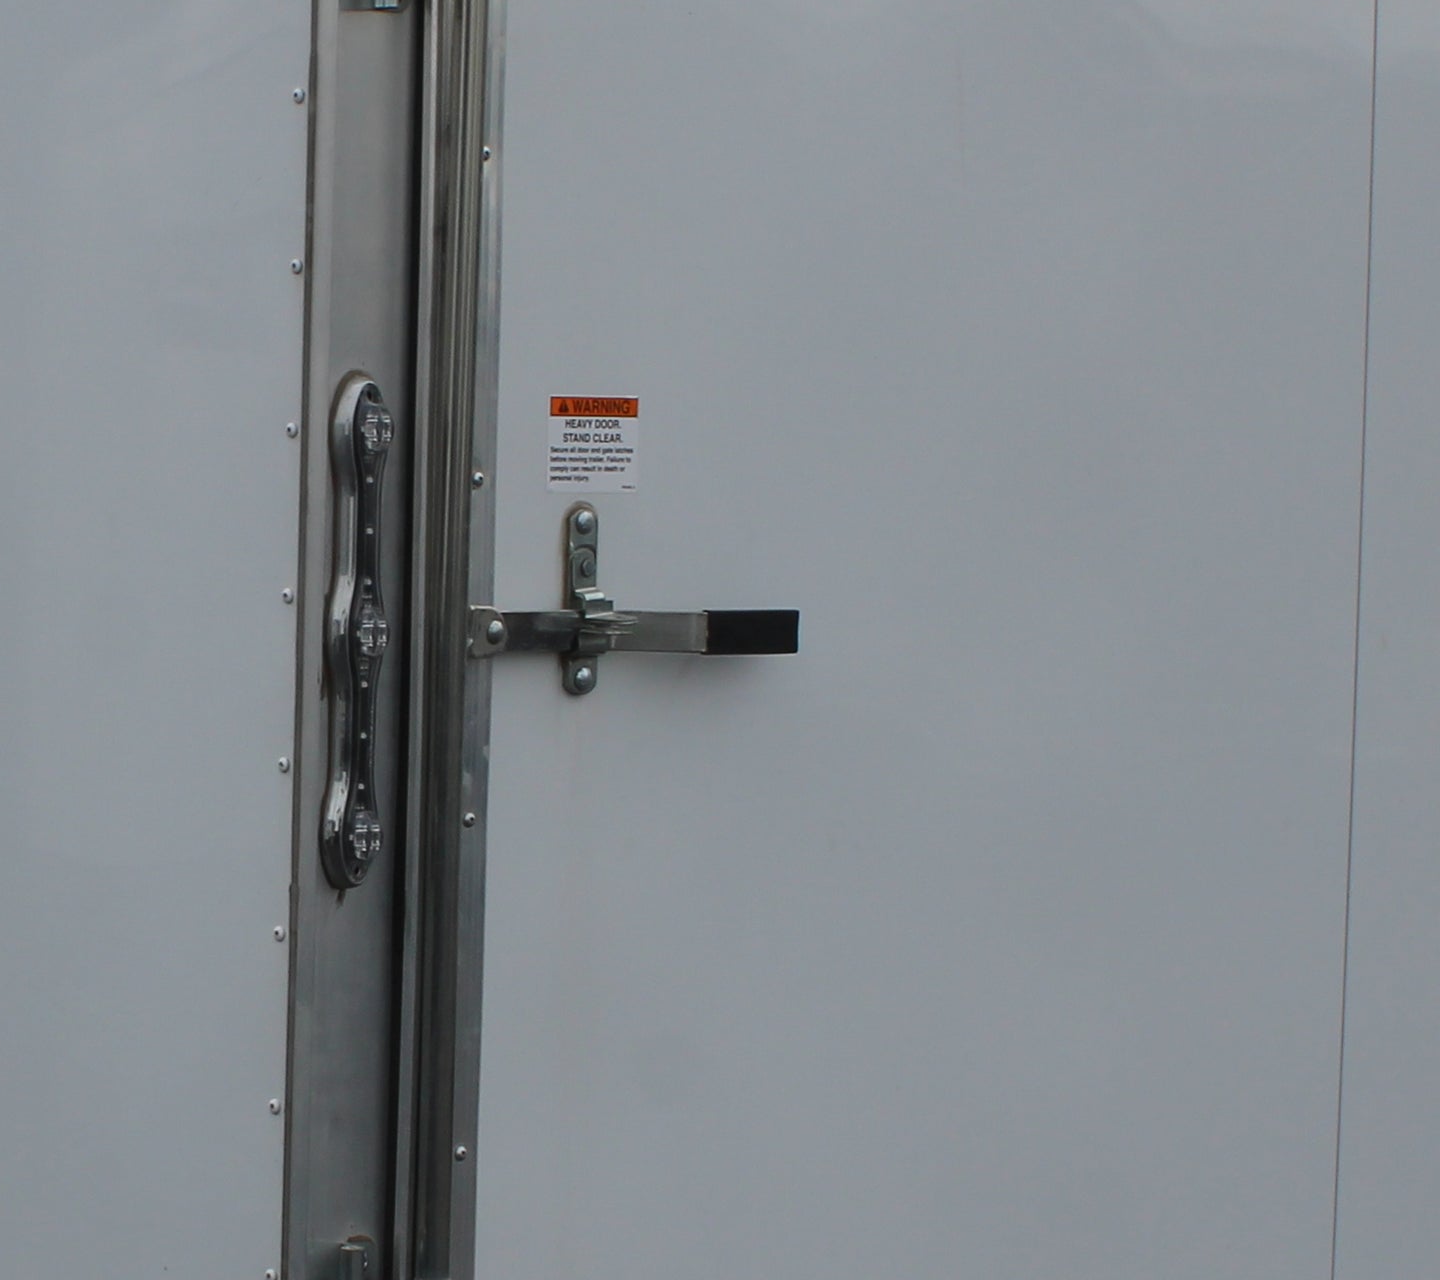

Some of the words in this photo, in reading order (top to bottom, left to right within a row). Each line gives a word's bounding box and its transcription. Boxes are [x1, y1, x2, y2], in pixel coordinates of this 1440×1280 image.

[572, 399, 631, 415] WARNING
[564, 419, 593, 429] HEAVY
[594, 419, 622, 429] DOOR.
[563, 433, 592, 443] STAND
[592, 433, 623, 443] CLEAR.
